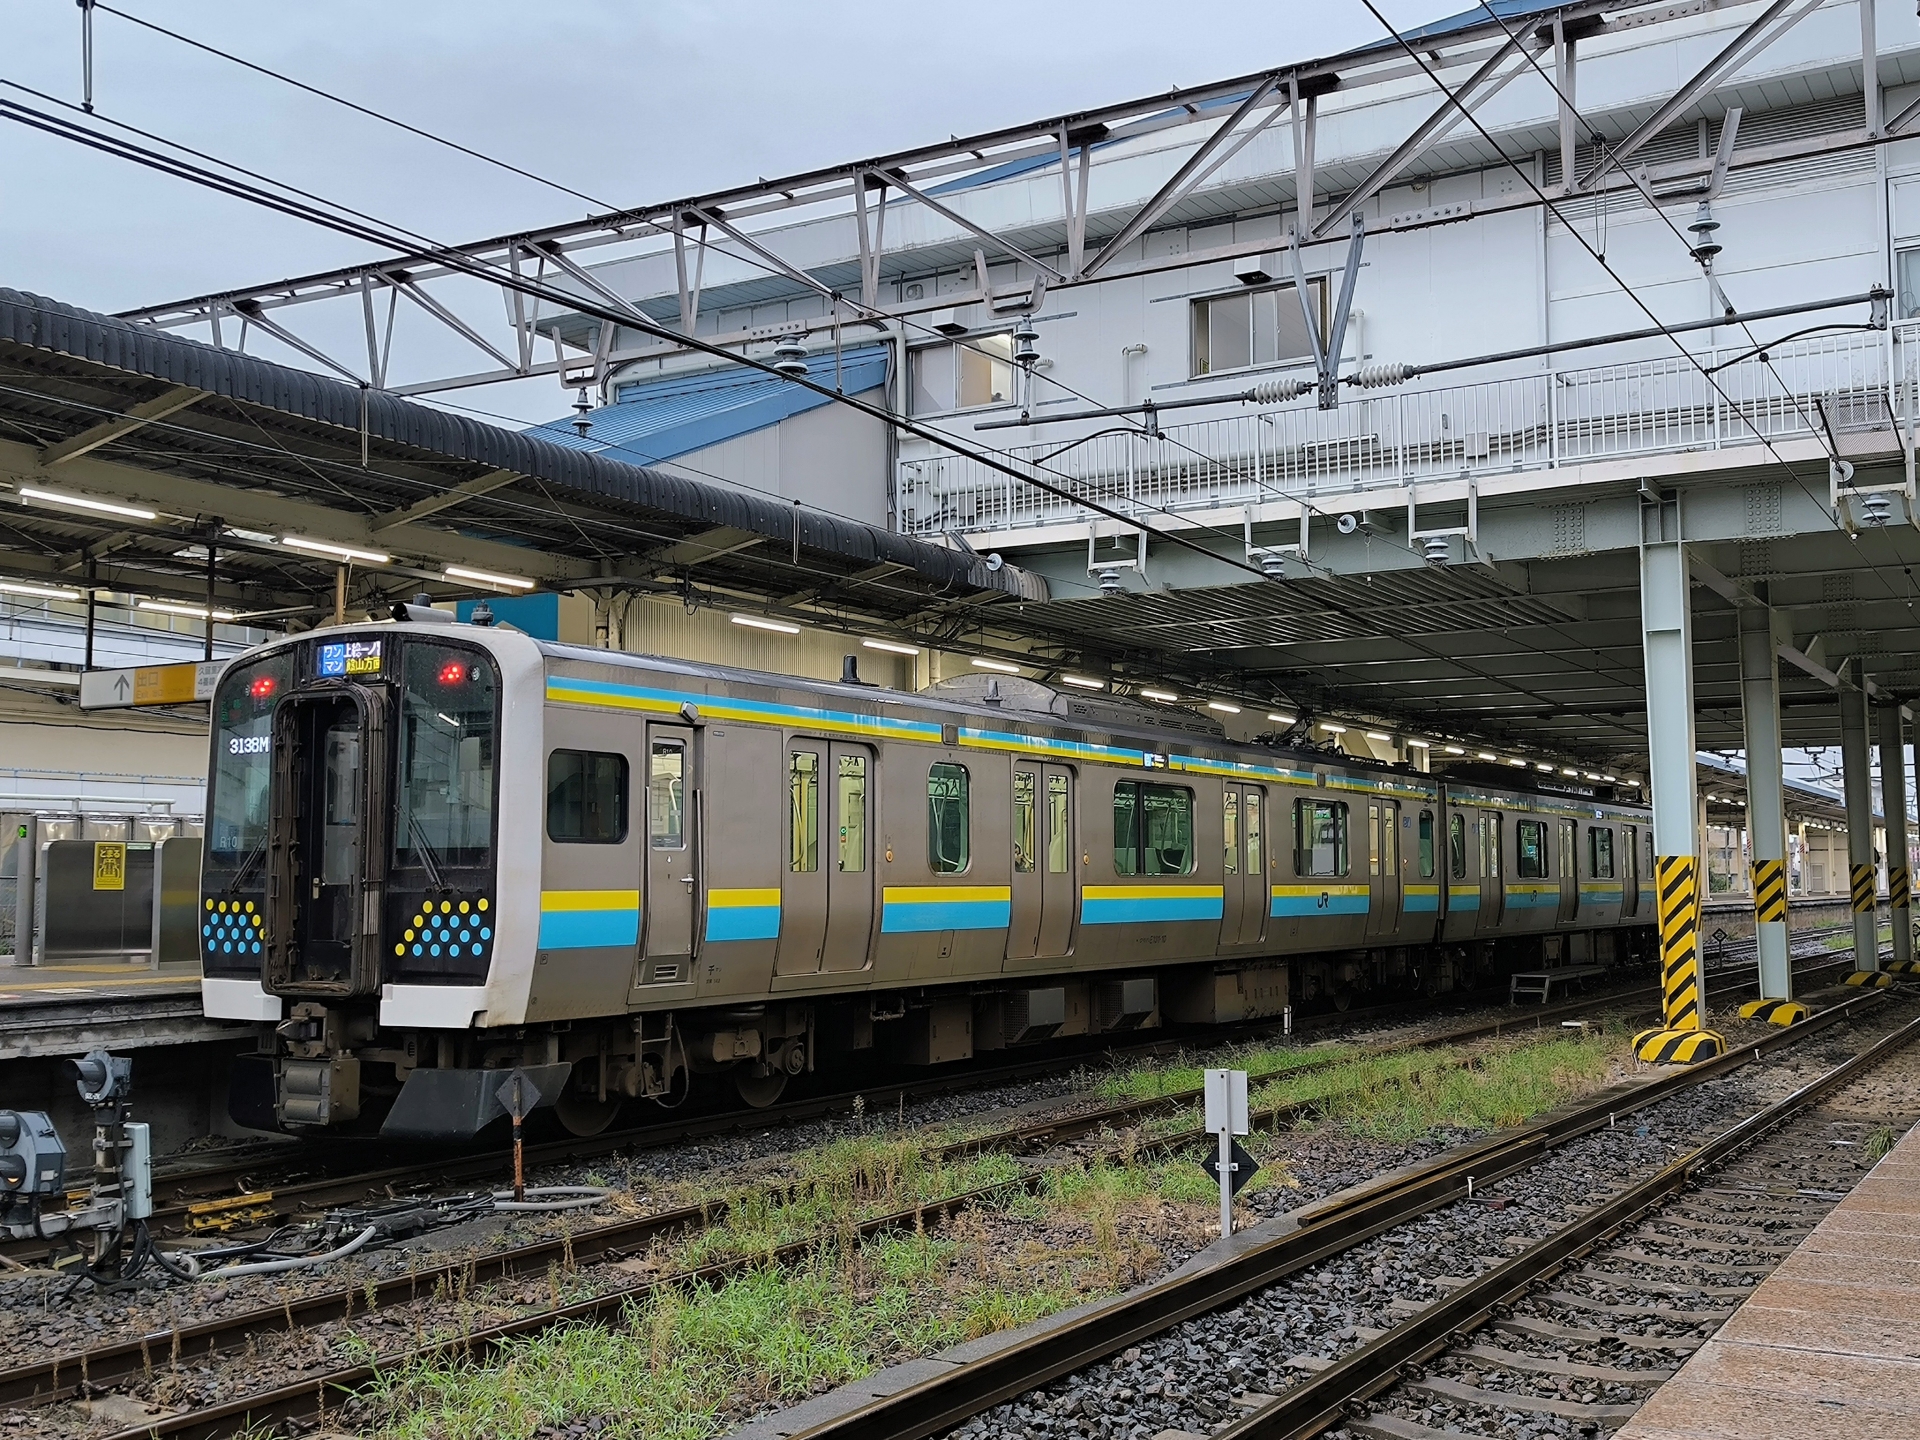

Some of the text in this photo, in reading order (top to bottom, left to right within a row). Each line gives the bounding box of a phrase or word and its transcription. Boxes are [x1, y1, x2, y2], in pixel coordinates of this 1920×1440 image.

[324, 645, 342, 658] ワン
[325, 660, 342, 672] マン
[229, 736, 269, 754] 3138M
[220, 836, 238, 848] R10
[100, 849, 121, 859] とまる
[1317, 891, 1329, 909] JR
